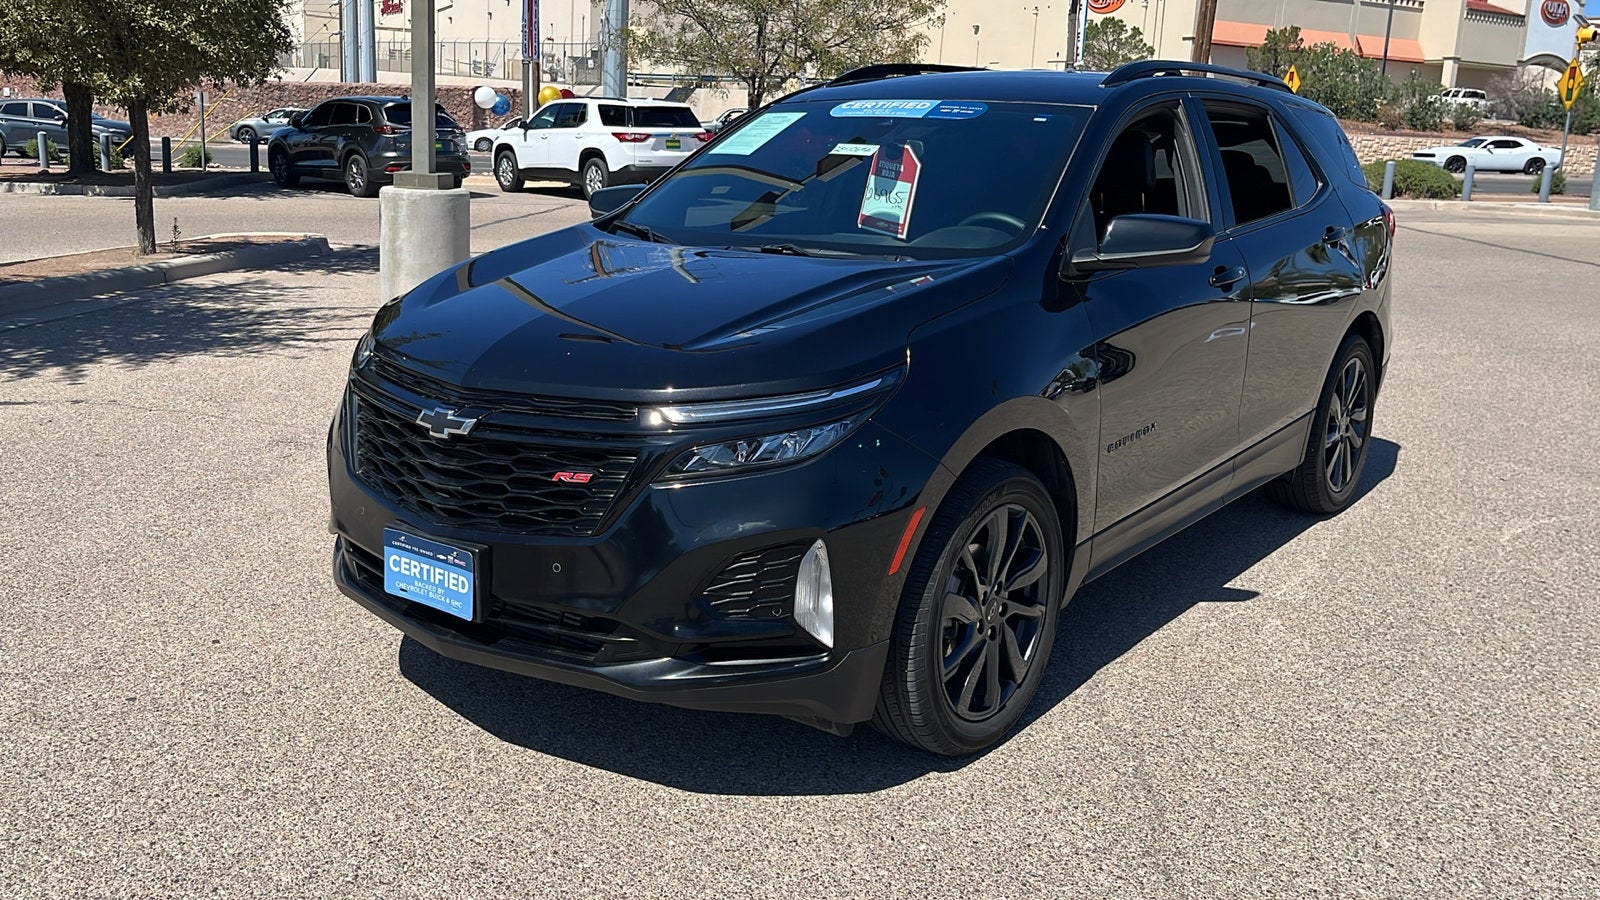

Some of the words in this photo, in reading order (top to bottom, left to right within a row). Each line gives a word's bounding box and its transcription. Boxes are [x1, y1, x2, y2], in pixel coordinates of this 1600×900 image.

[840, 101, 931, 110] CERTIFIED
[878, 160, 904, 172] ETIQUETA
[881, 170, 896, 178] ROJA
[1107, 422, 1157, 454] EQUINOX
[551, 471, 593, 484] RS
[389, 555, 469, 594] CERTIFIED
[414, 581, 437, 592] BACKED
[396, 581, 427, 595] CHEVROLET
[429, 592, 445, 601] BUICK
[451, 600, 463, 608] GMC
